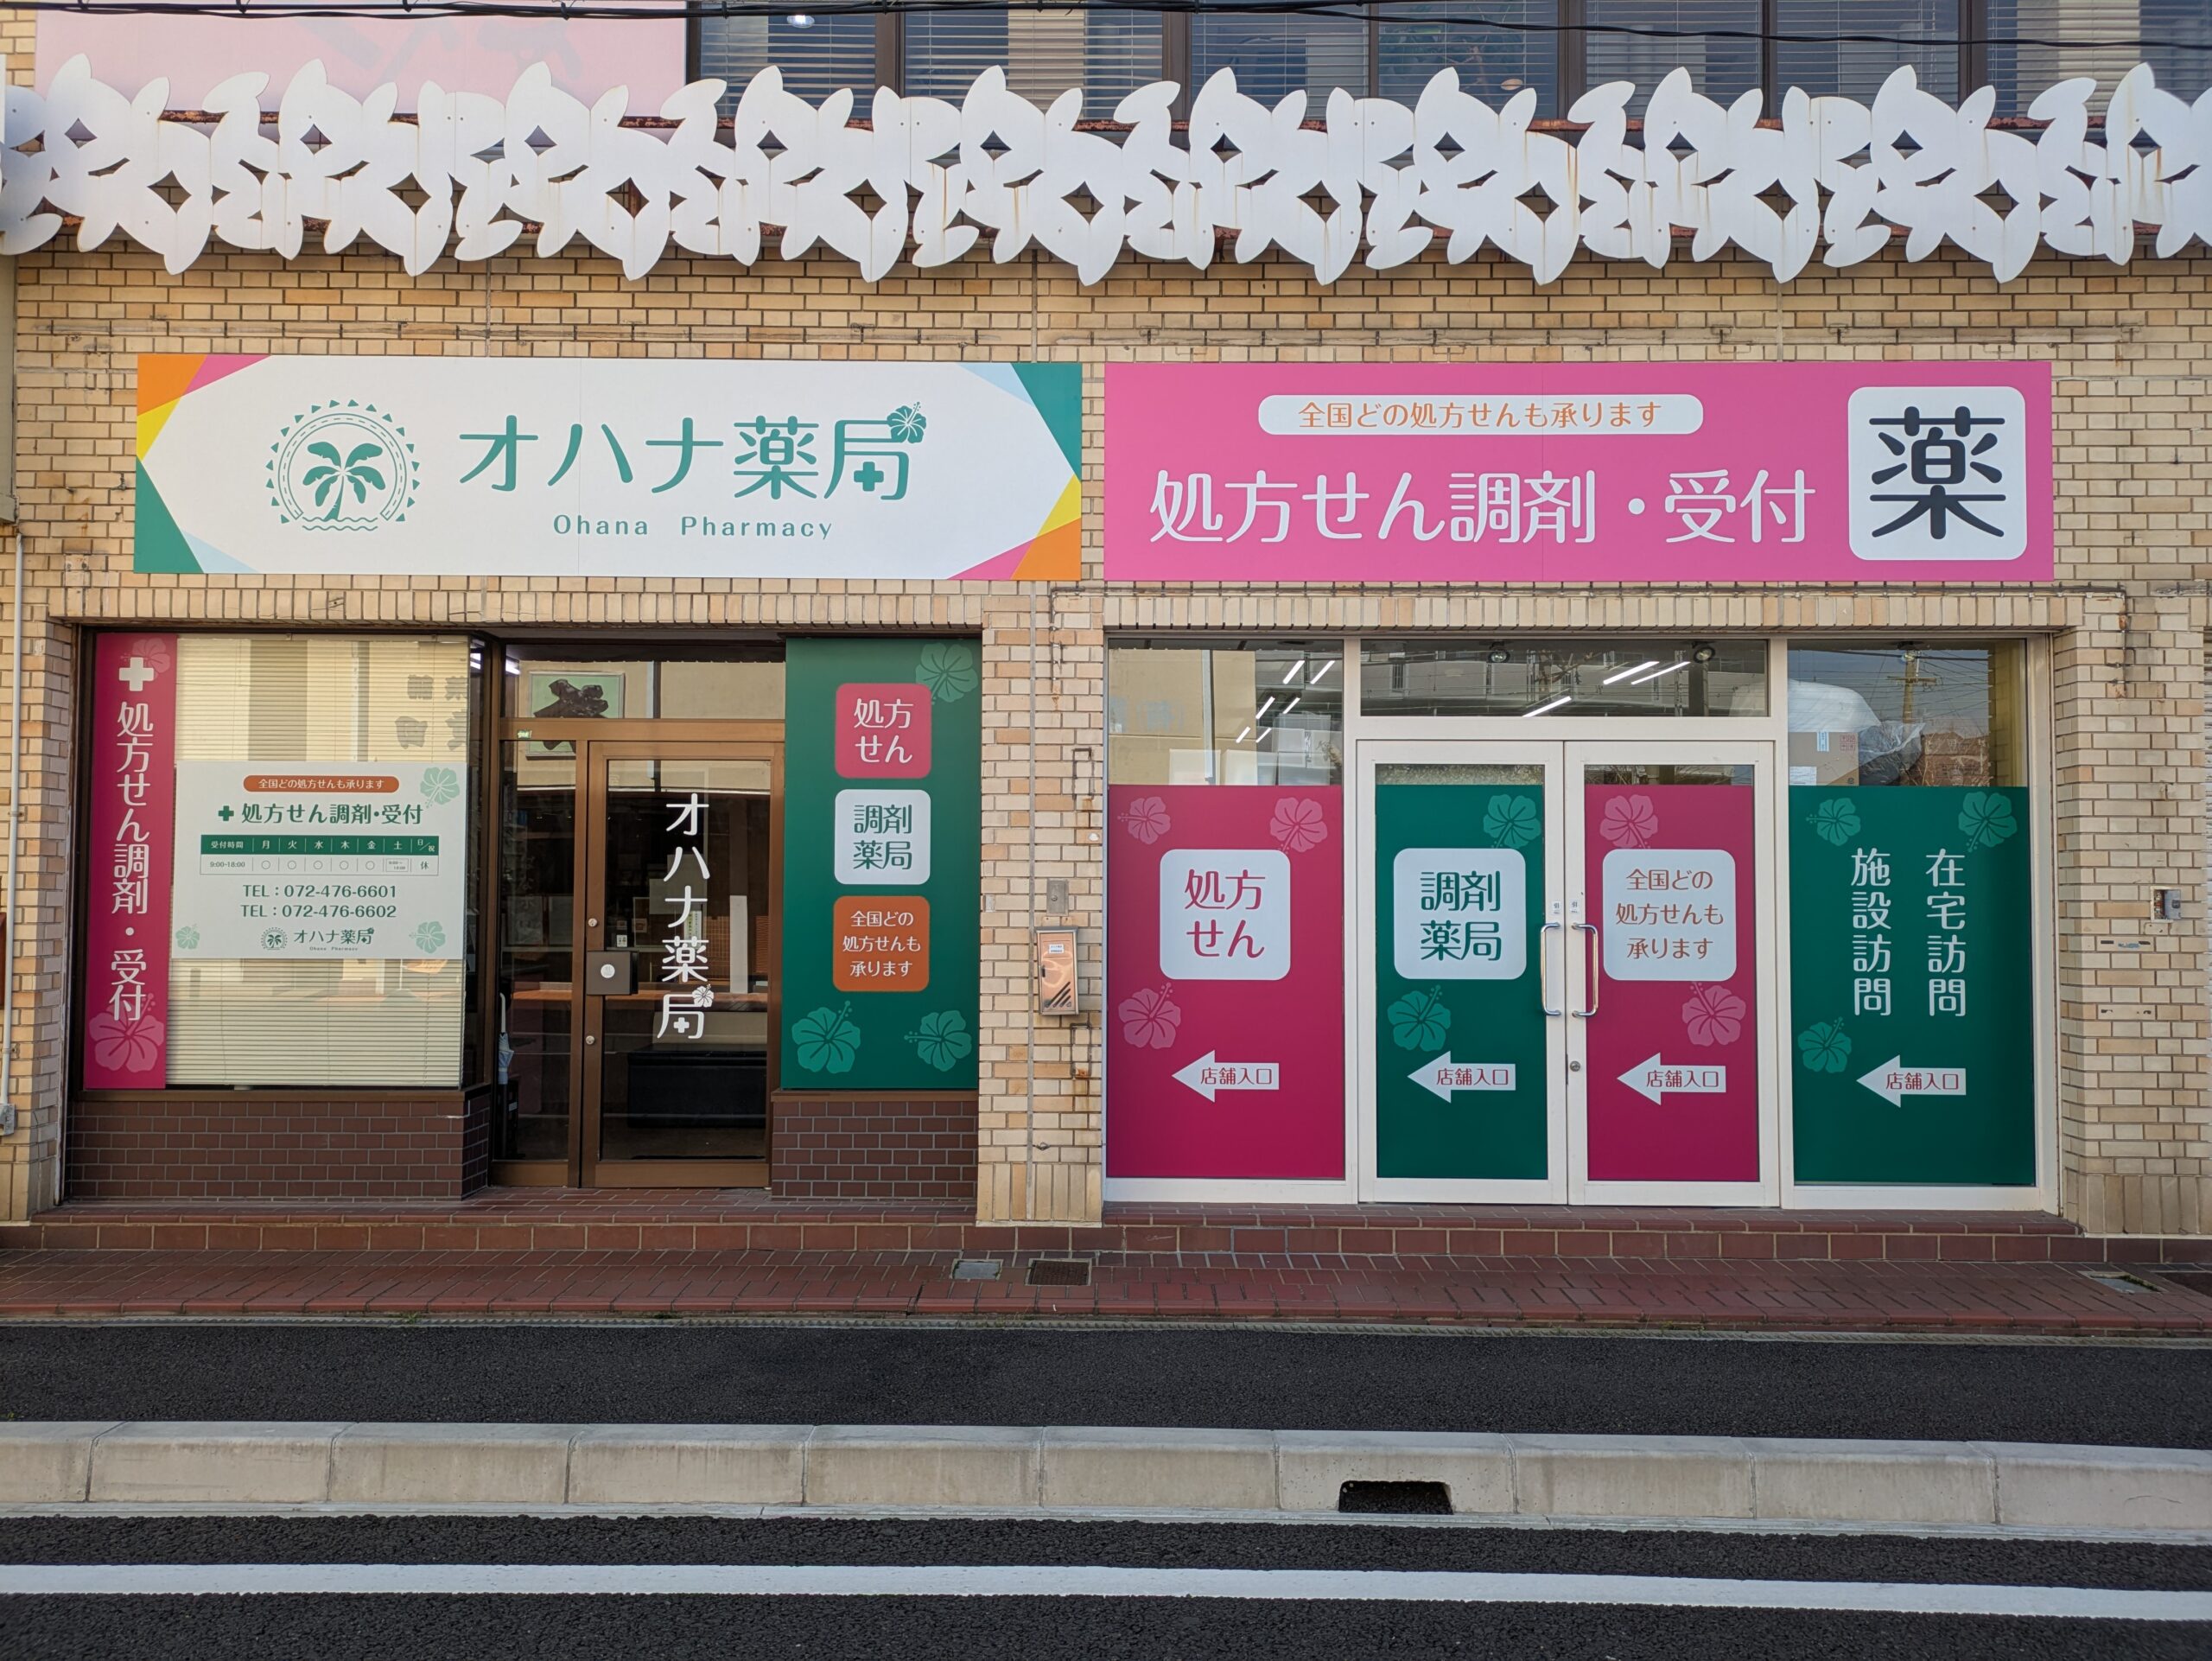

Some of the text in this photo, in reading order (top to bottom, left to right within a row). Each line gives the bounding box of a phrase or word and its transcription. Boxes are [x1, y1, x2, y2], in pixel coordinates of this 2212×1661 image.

[1299, 402, 1661, 428] 全国どの処方せんも承ります
[459, 412, 914, 501] オハナ薬局
[1869, 406, 2005, 539] 薬
[1150, 469, 1815, 543] 処方せん調剤・受付
[554, 515, 831, 539] Ohana Pharmacy
[855, 698, 913, 728] 処方
[855, 735, 912, 763] せん
[257, 779, 385, 790] 全国どの処方せんも承ります
[854, 805, 912, 833] 調剤
[211, 840, 244, 849] 受付時間
[289, 840, 296, 849] 火
[394, 841, 401, 850] 土
[854, 840, 912, 869] 薬局
[1185, 869, 1265, 909] 処方
[1421, 871, 1500, 911] 調剤
[1626, 869, 1713, 890] 全国どの
[657, 792, 712, 1039] オハナ薬局
[851, 911, 913, 926] 全国どの
[1617, 903, 1723, 925] 処方せんも
[294, 928, 373, 945] オハナ薬局
[843, 936, 920, 951] 処方せんも
[1186, 920, 1264, 958] せん
[1421, 920, 1501, 961] 薬局
[1851, 848, 1891, 1015] 施設訪問
[1926, 849, 1966, 1016] 在宅訪問
[1628, 938, 1713, 959] 承ります
[850, 961, 912, 977] 承ります
[1201, 1067, 1272, 1085] 店舗入口
[1437, 1068, 1508, 1085] 店舗入口
[1647, 1070, 1719, 1087] 店舗入口
[1886, 1072, 1958, 1090] 店舗入口
